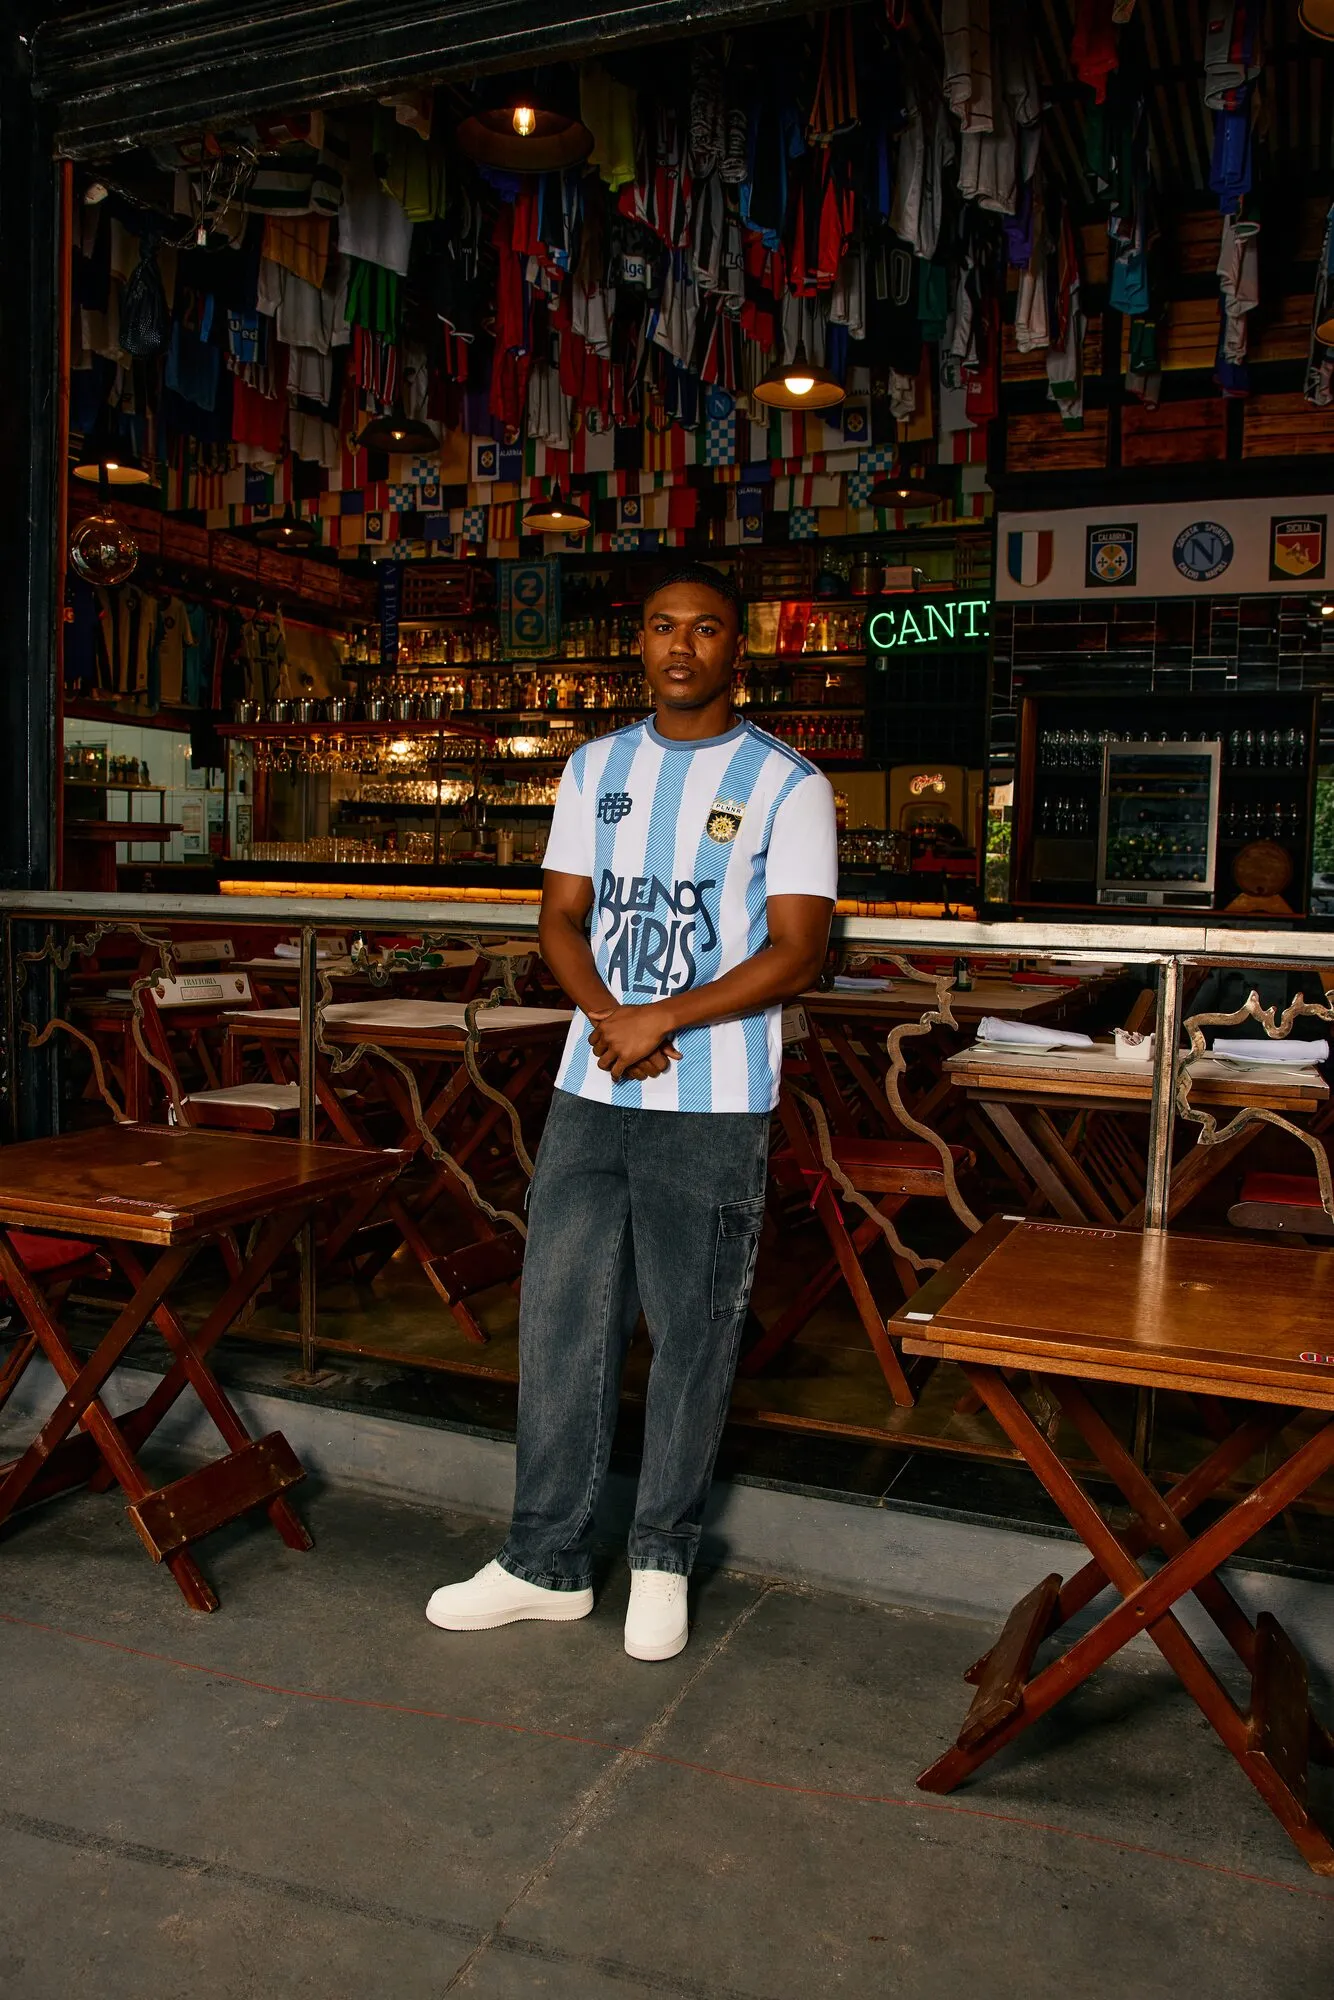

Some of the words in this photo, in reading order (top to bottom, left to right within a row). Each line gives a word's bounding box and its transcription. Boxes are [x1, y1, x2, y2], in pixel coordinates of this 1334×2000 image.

[1286, 523, 1312, 533] SICILIA
[1190, 538, 1216, 566] N
[869, 600, 991, 649] CANT
[715, 803, 742, 815] PLNNR
[598, 868, 719, 953] BUENOS
